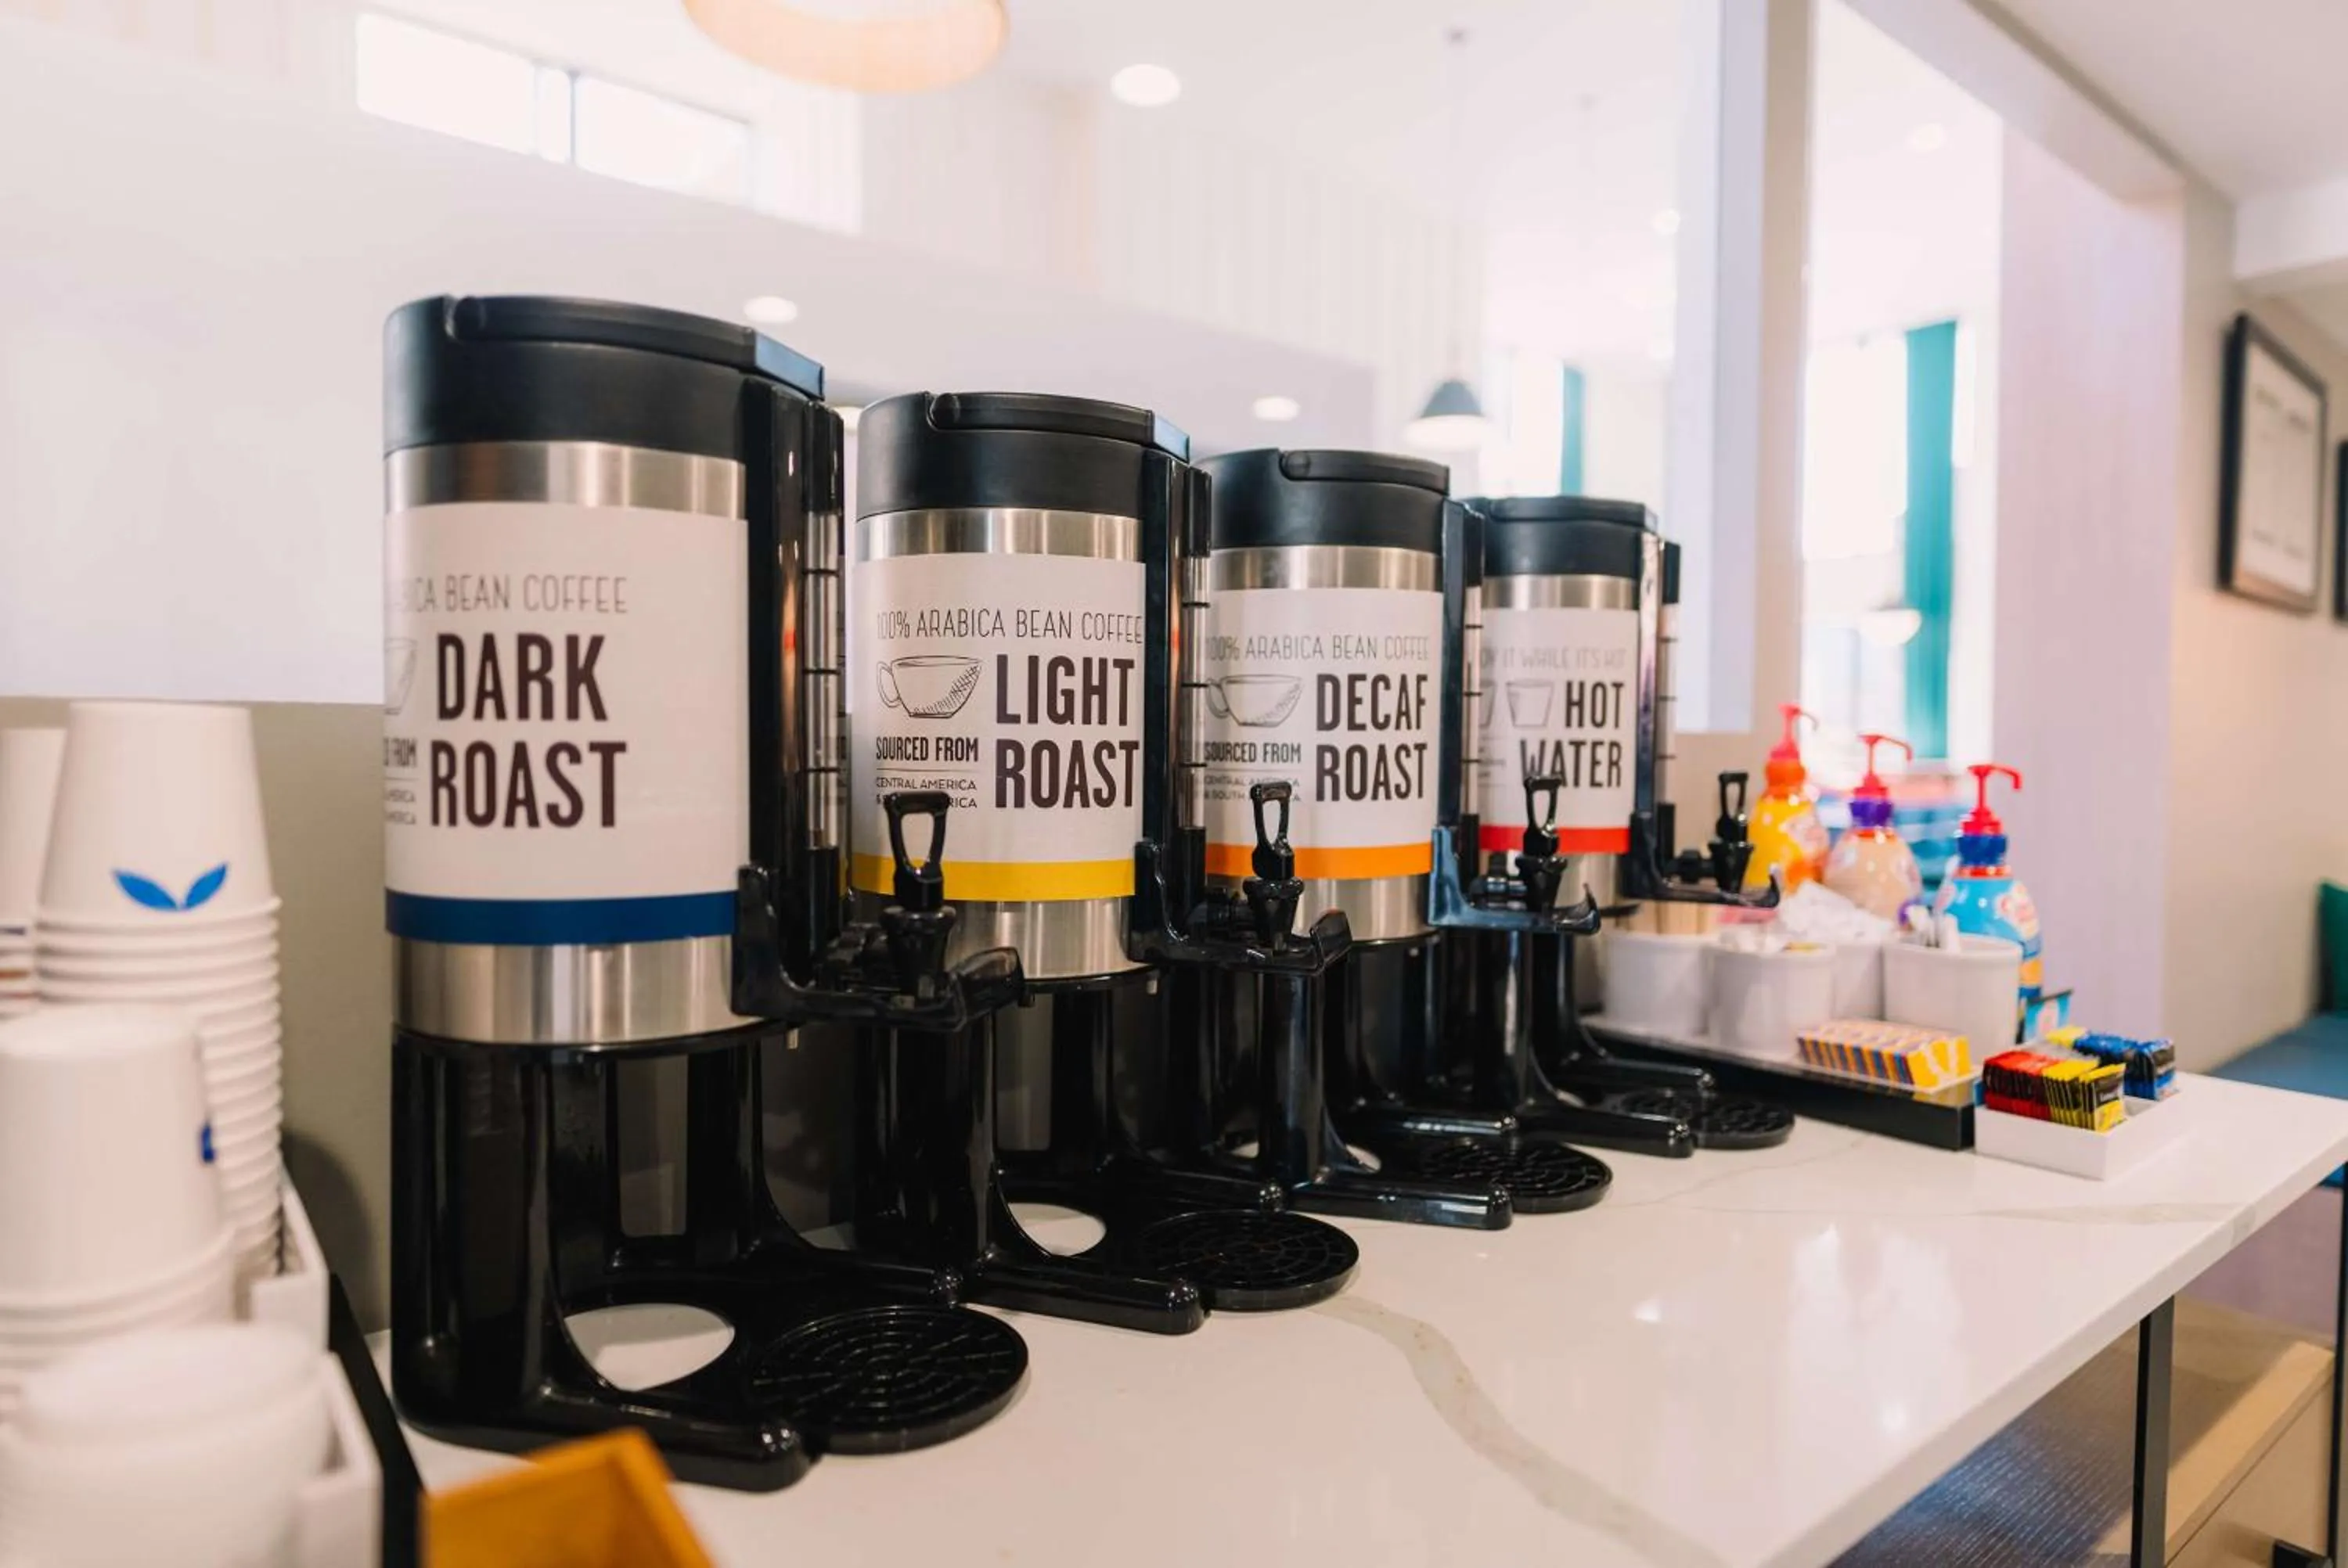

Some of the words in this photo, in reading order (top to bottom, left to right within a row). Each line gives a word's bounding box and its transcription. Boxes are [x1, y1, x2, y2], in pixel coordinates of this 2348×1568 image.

[445, 574, 510, 613] BEAN
[523, 574, 628, 614] COFFEE
[916, 609, 1006, 638] ARABICA
[1016, 610, 1072, 639] BEAN
[1082, 612, 1143, 644] COFFEE
[1245, 635, 1324, 661] ARABICA
[1332, 634, 1377, 660] BEAN
[1384, 635, 1429, 661] COFFEE
[437, 632, 608, 721] DARK
[996, 654, 1135, 726] LIGHT
[1316, 673, 1428, 731] DECAF
[1565, 681, 1624, 728] HOT
[876, 736, 928, 761] SOURCED
[935, 736, 978, 762] FROM
[1205, 741, 1257, 763] SOURCED
[1262, 742, 1302, 764] FROM
[1316, 743, 1428, 802] ROAST
[1520, 739, 1622, 788] WATER
[430, 740, 627, 829] ROAST
[876, 776, 917, 789] CENTRAL
[920, 778, 977, 790] AMERICA
[995, 739, 1140, 809] ROAST
